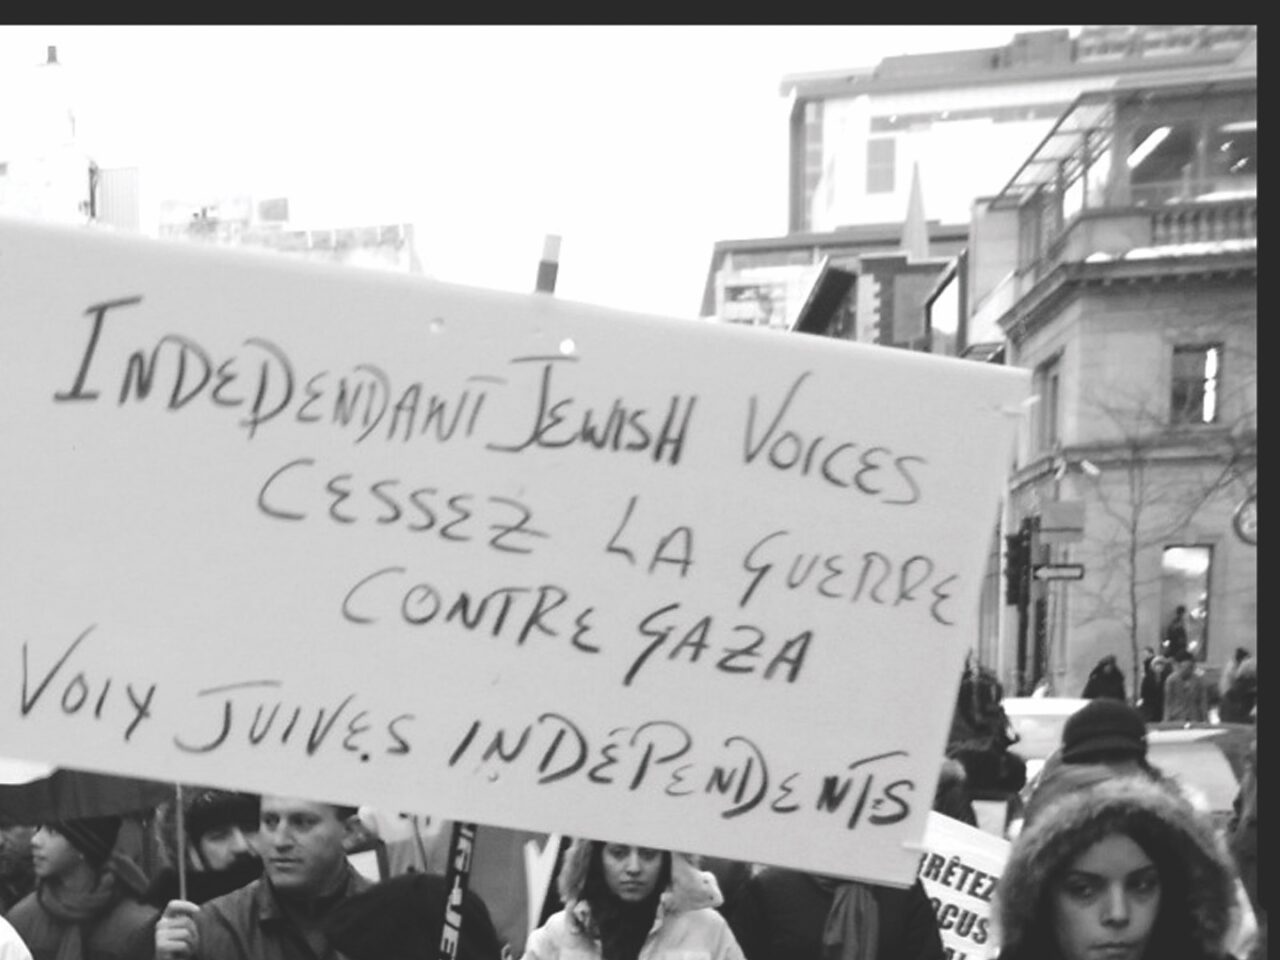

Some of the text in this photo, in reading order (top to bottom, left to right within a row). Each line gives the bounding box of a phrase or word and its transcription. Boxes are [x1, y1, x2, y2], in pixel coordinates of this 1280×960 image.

[486, 355, 697, 465] JEWISH
[744, 371, 928, 504] VOICES
[257, 458, 962, 627] CESSEZ LA GUERRE
[342, 568, 815, 687] CONTRE GAZA
